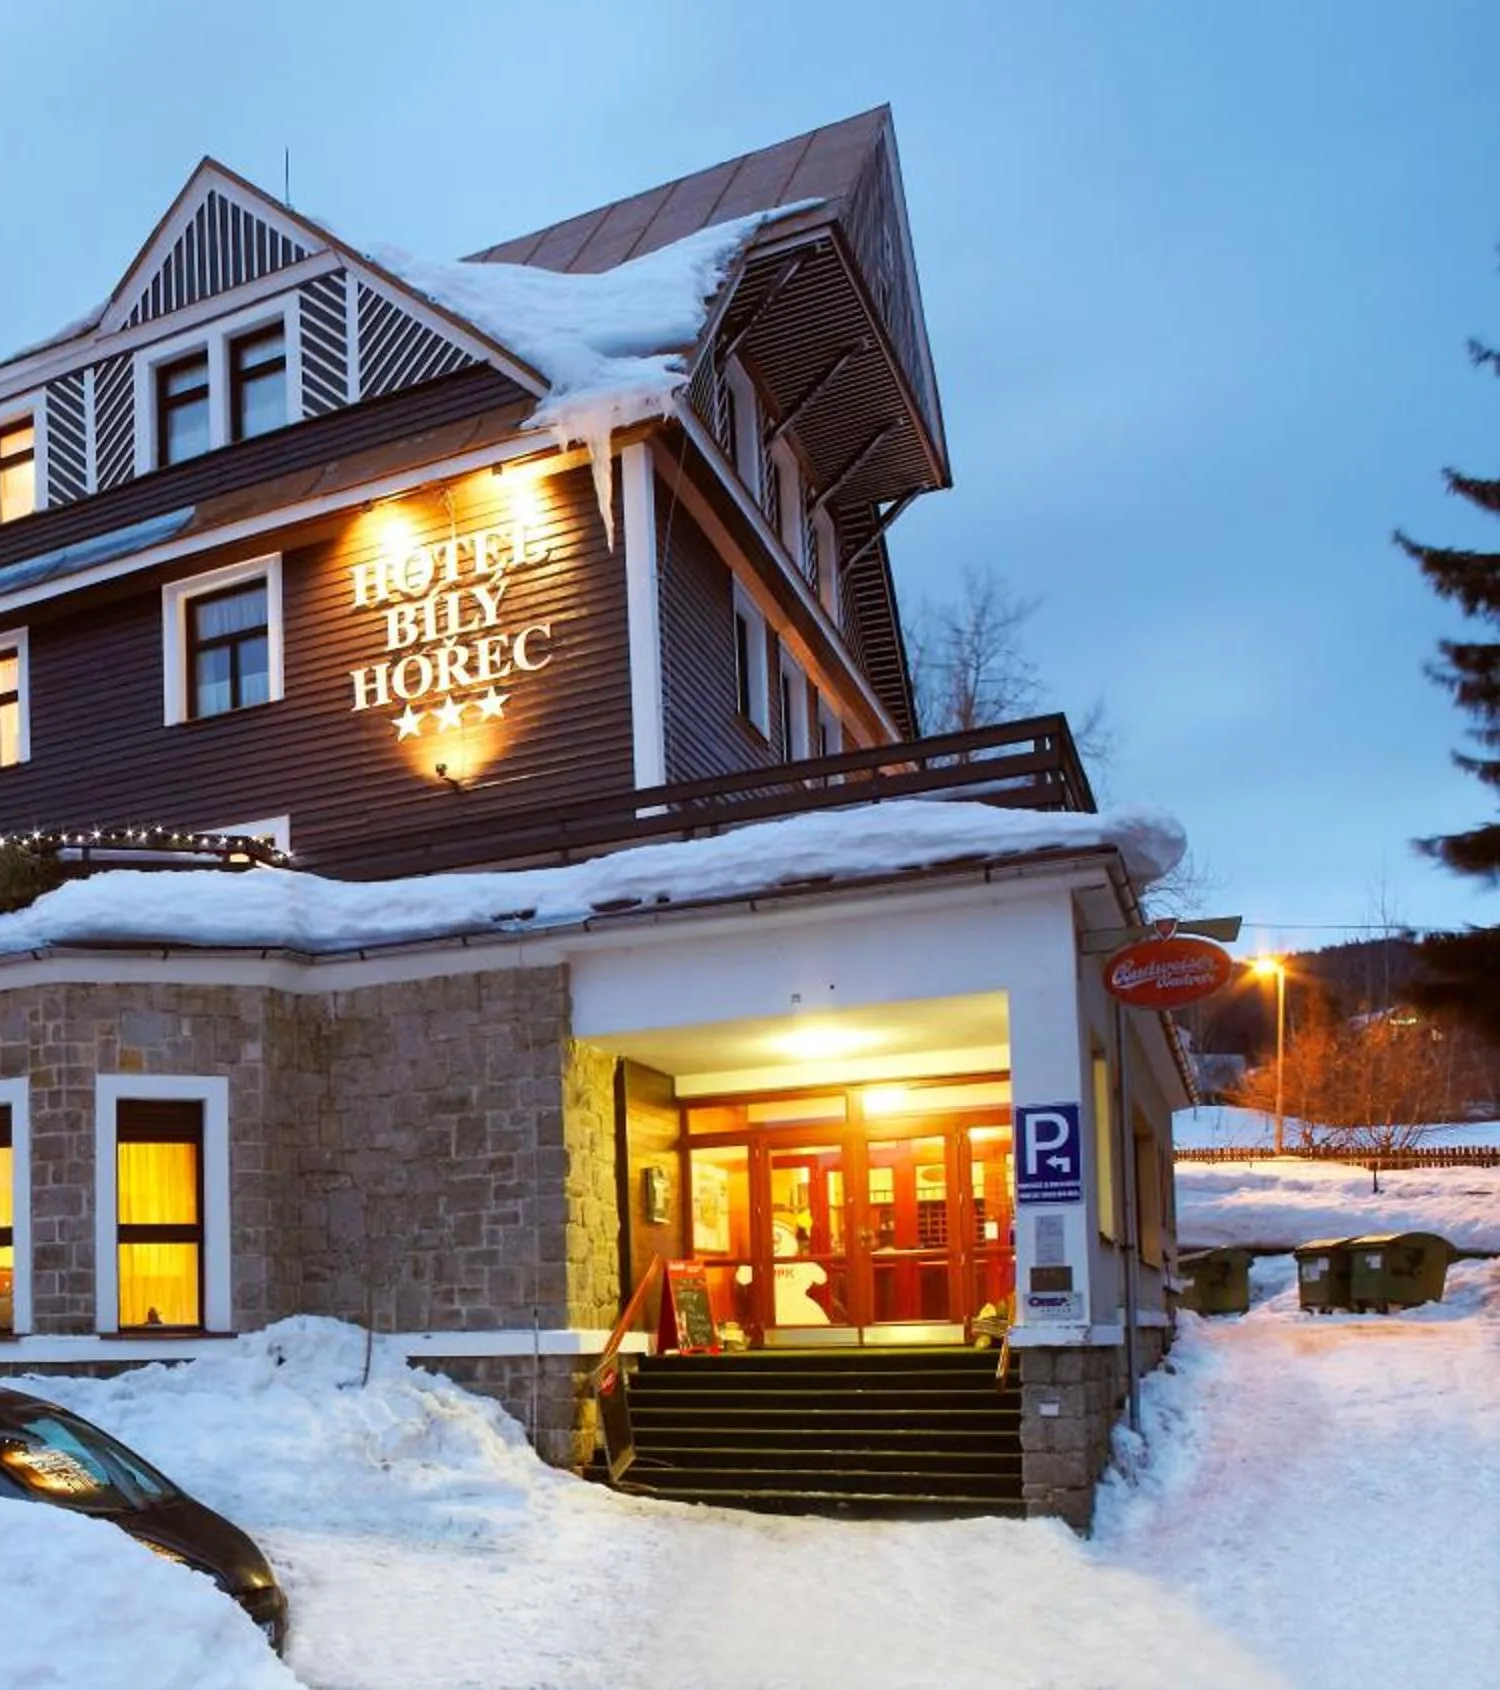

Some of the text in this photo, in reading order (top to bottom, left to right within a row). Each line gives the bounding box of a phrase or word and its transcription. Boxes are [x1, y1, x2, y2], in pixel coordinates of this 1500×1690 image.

[351, 522, 552, 607] HOTEL
[381, 570, 510, 652] BÍLÝ
[350, 623, 552, 711] HOŘEC
[1025, 1113, 1070, 1175] P
